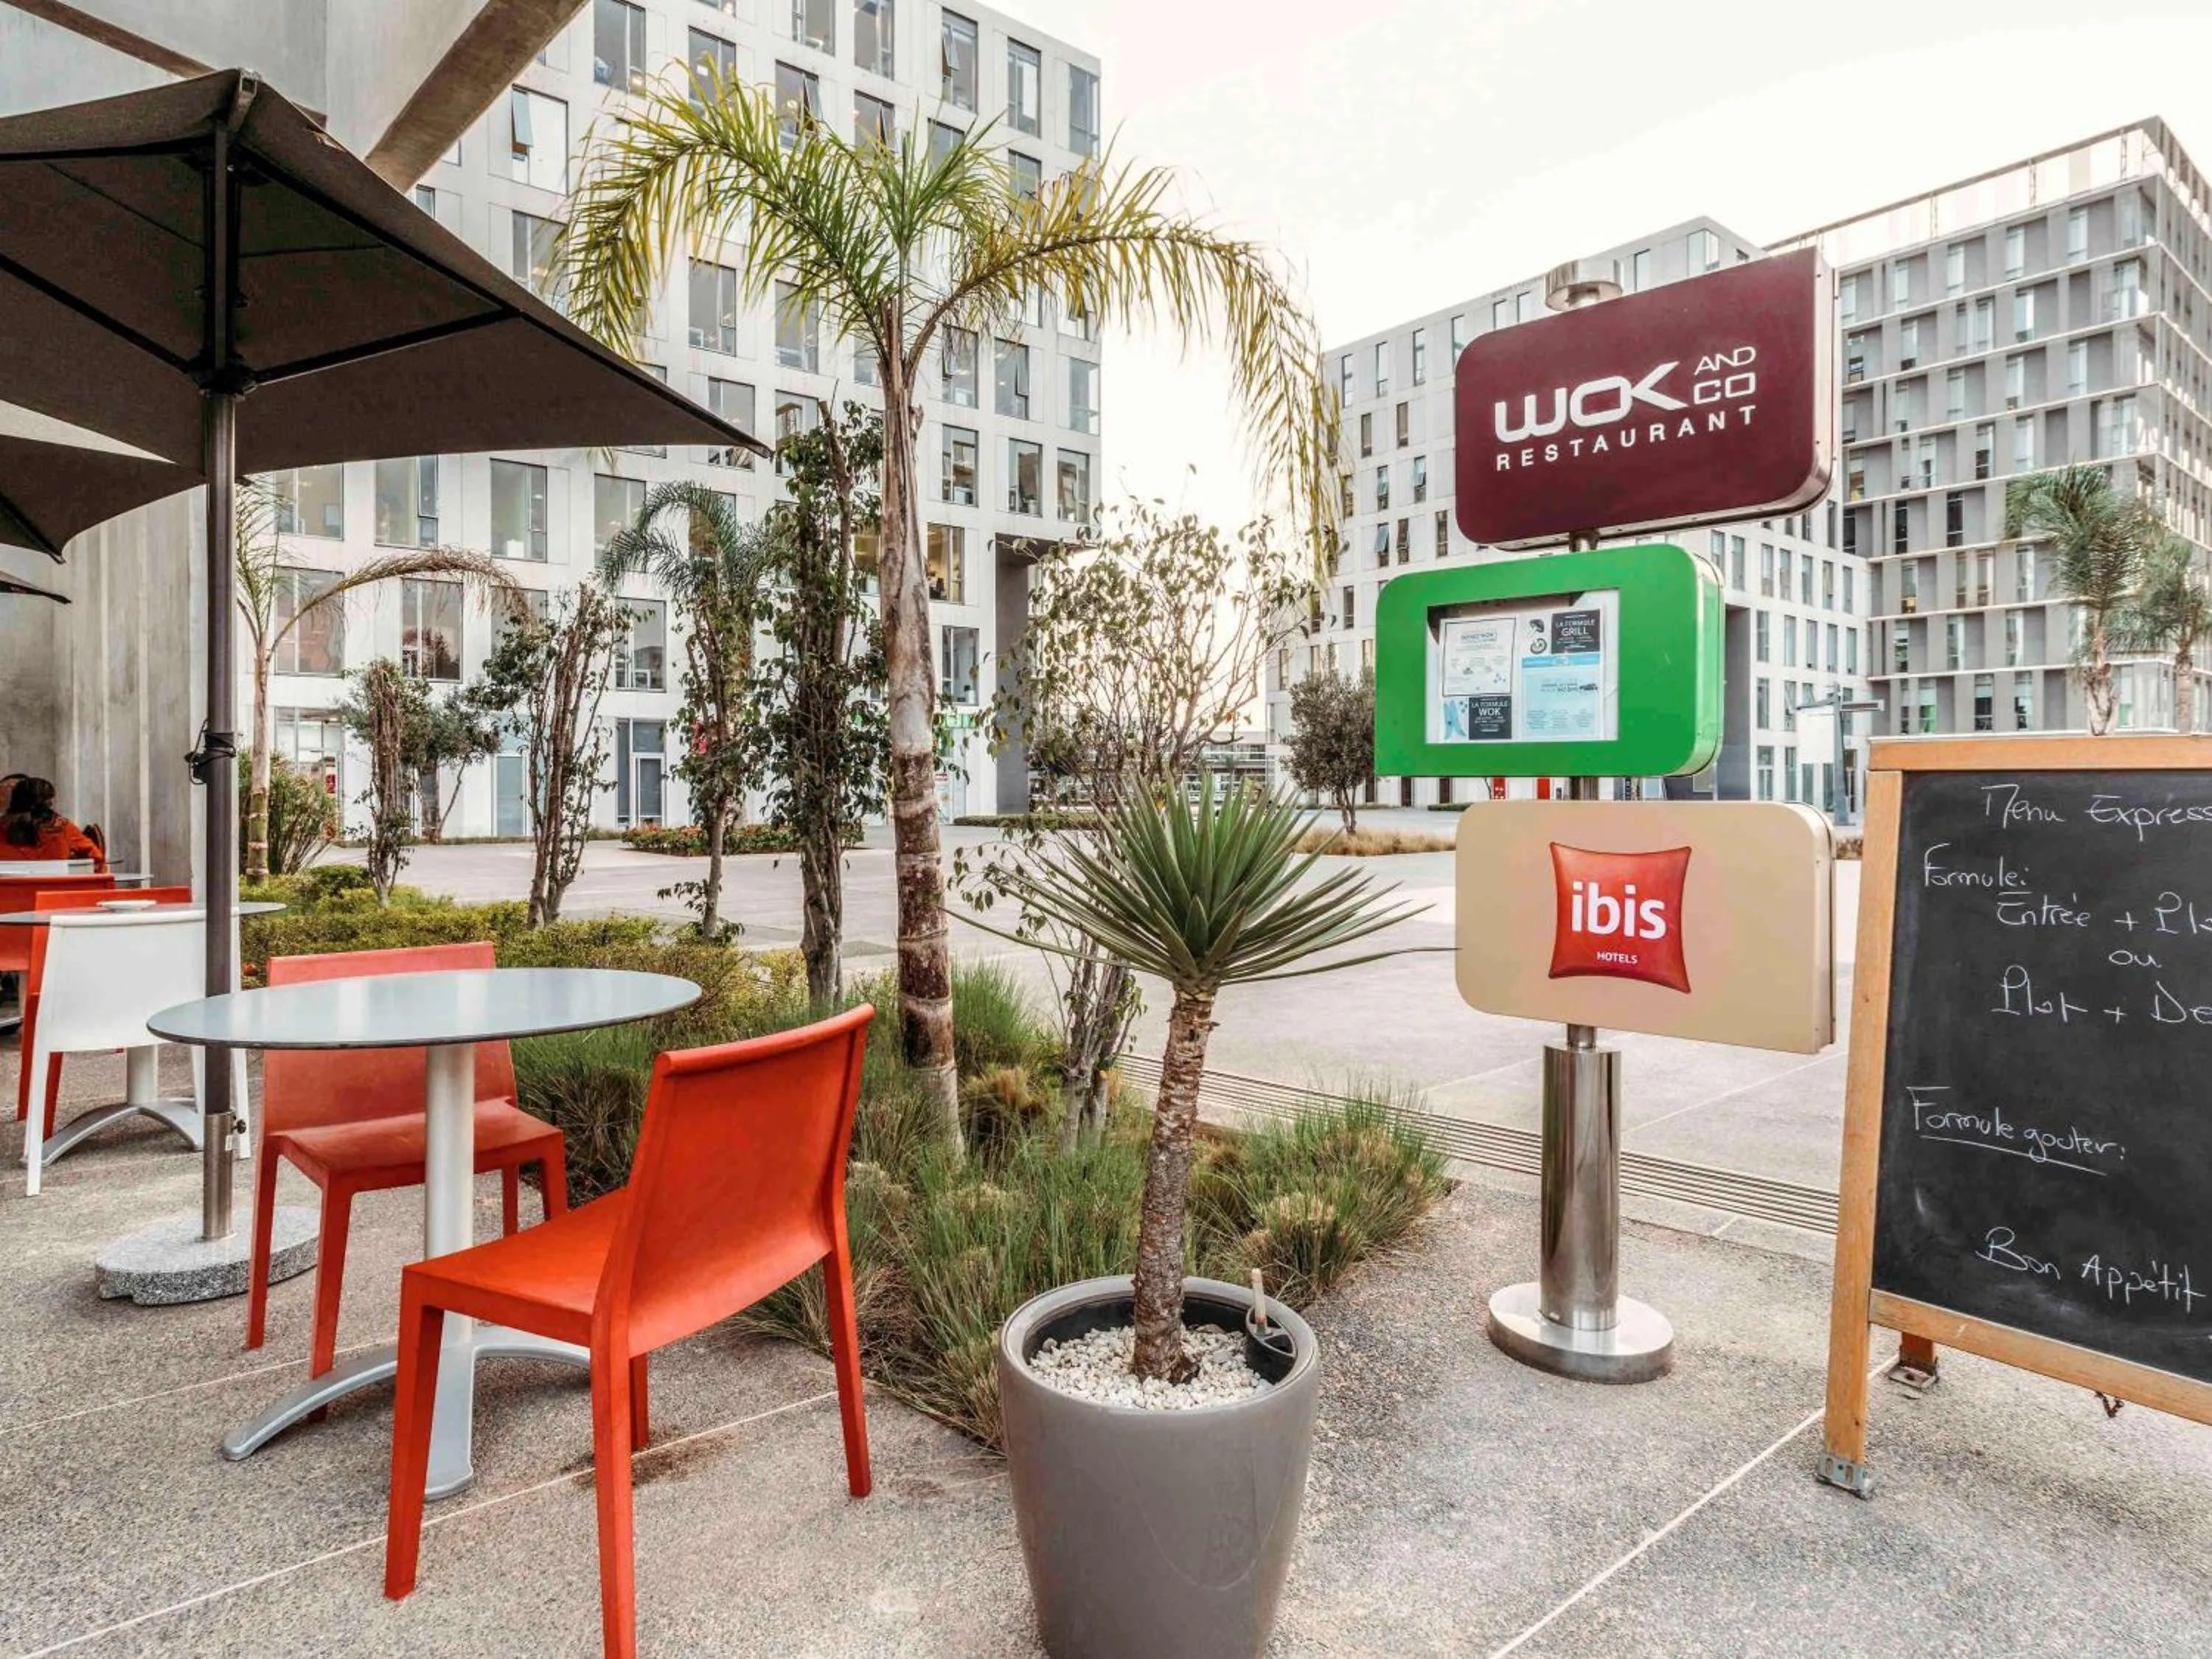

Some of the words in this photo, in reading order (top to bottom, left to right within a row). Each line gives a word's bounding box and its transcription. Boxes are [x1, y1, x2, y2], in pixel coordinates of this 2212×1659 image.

[1694, 346, 1756, 375] AND
[1495, 361, 1688, 443] WOK
[1694, 372, 1756, 405] CO
[1496, 406, 1756, 472] RESTAURANT
[1561, 626, 1589, 636] GRILL
[1478, 707, 1500, 716] WOK
[1981, 784, 2065, 830] Menu
[1924, 843, 2029, 887] Formule:
[1571, 881, 1666, 940] ibis
[1596, 951, 1638, 964] HOTELS
[1906, 1086, 2014, 1140] Formule
[1975, 1226, 2061, 1281] Bon
